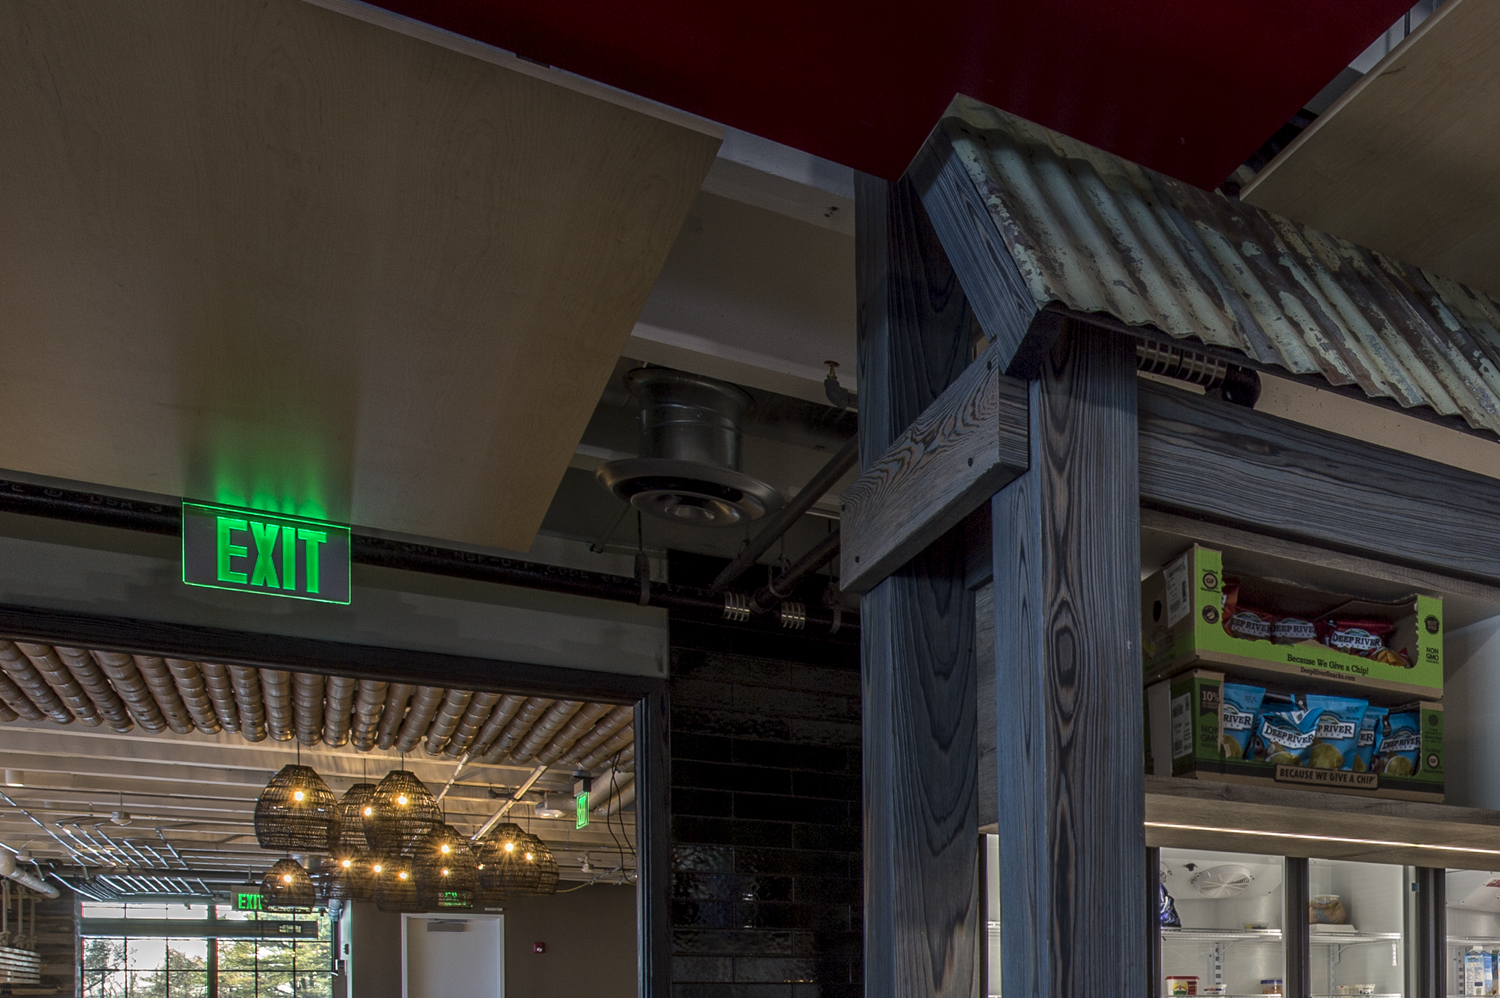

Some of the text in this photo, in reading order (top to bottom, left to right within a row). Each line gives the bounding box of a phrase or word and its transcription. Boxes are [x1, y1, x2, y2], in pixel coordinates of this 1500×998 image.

[216, 516, 328, 594] EXIT
[1231, 618, 1246, 628] EEP
[1294, 625, 1315, 634] RIVE
[1332, 634, 1380, 647] DEEP RIVER
[1426, 653, 1440, 661] GMO
[1287, 653, 1316, 667] Because
[1317, 658, 1328, 667] We
[1328, 661, 1345, 671] Give
[1351, 664, 1369, 677] Chip!
[1300, 667, 1356, 681] DeepRiverSnacks.com
[1202, 691, 1221, 703] 10%
[1224, 714, 1251, 725] RIVER
[1265, 725, 1314, 744] DEEP RIVER
[1325, 725, 1353, 736] RIVER
[1400, 737, 1421, 746] RIVER
[1280, 768, 1374, 785] BECAUSE WE GIVE A CHIP
[238, 893, 264, 909] EXIT
